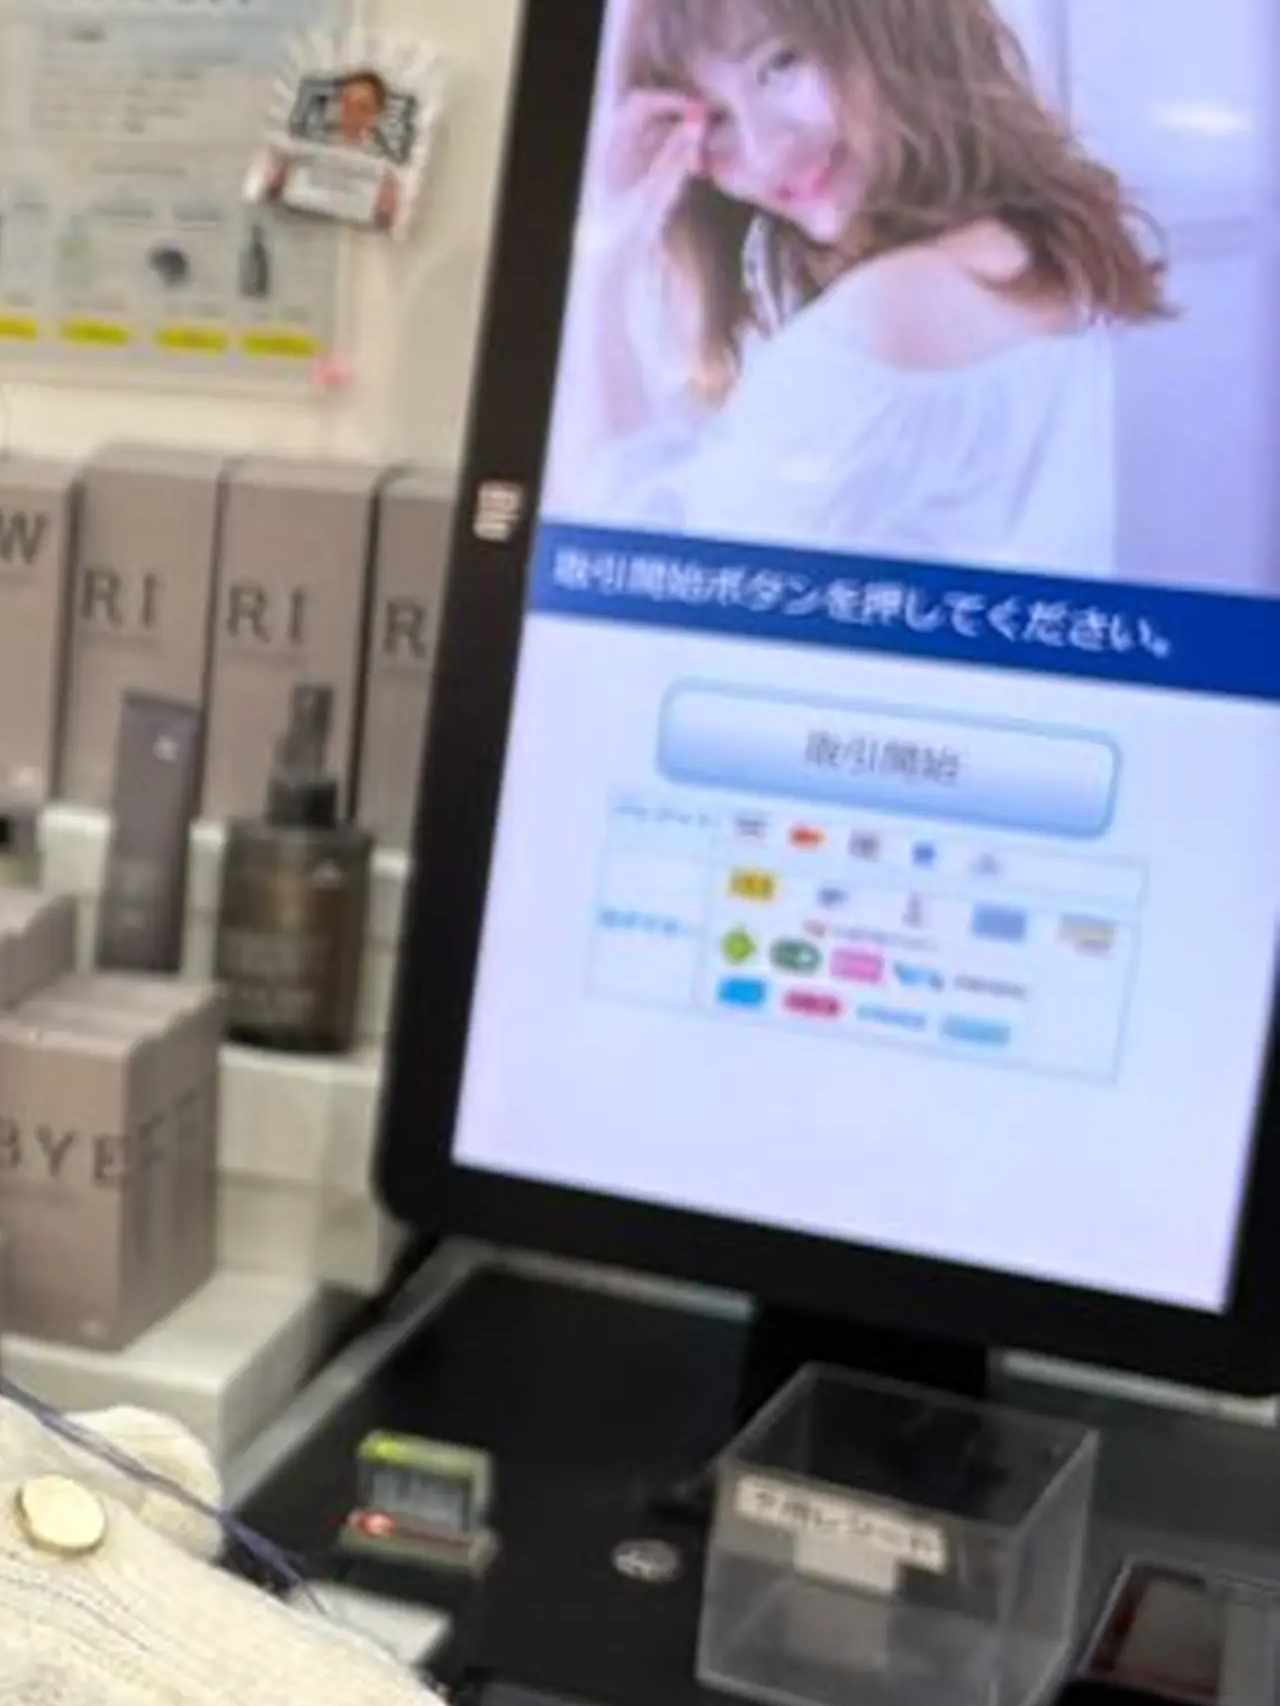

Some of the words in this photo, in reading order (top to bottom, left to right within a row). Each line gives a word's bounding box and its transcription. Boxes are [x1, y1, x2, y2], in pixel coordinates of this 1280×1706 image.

[81, 565, 162, 630] RI
[226, 580, 307, 646] RI
[552, 544, 1174, 660] 取引開始ボタンを押してください。
[802, 728, 964, 790] 取引開始
